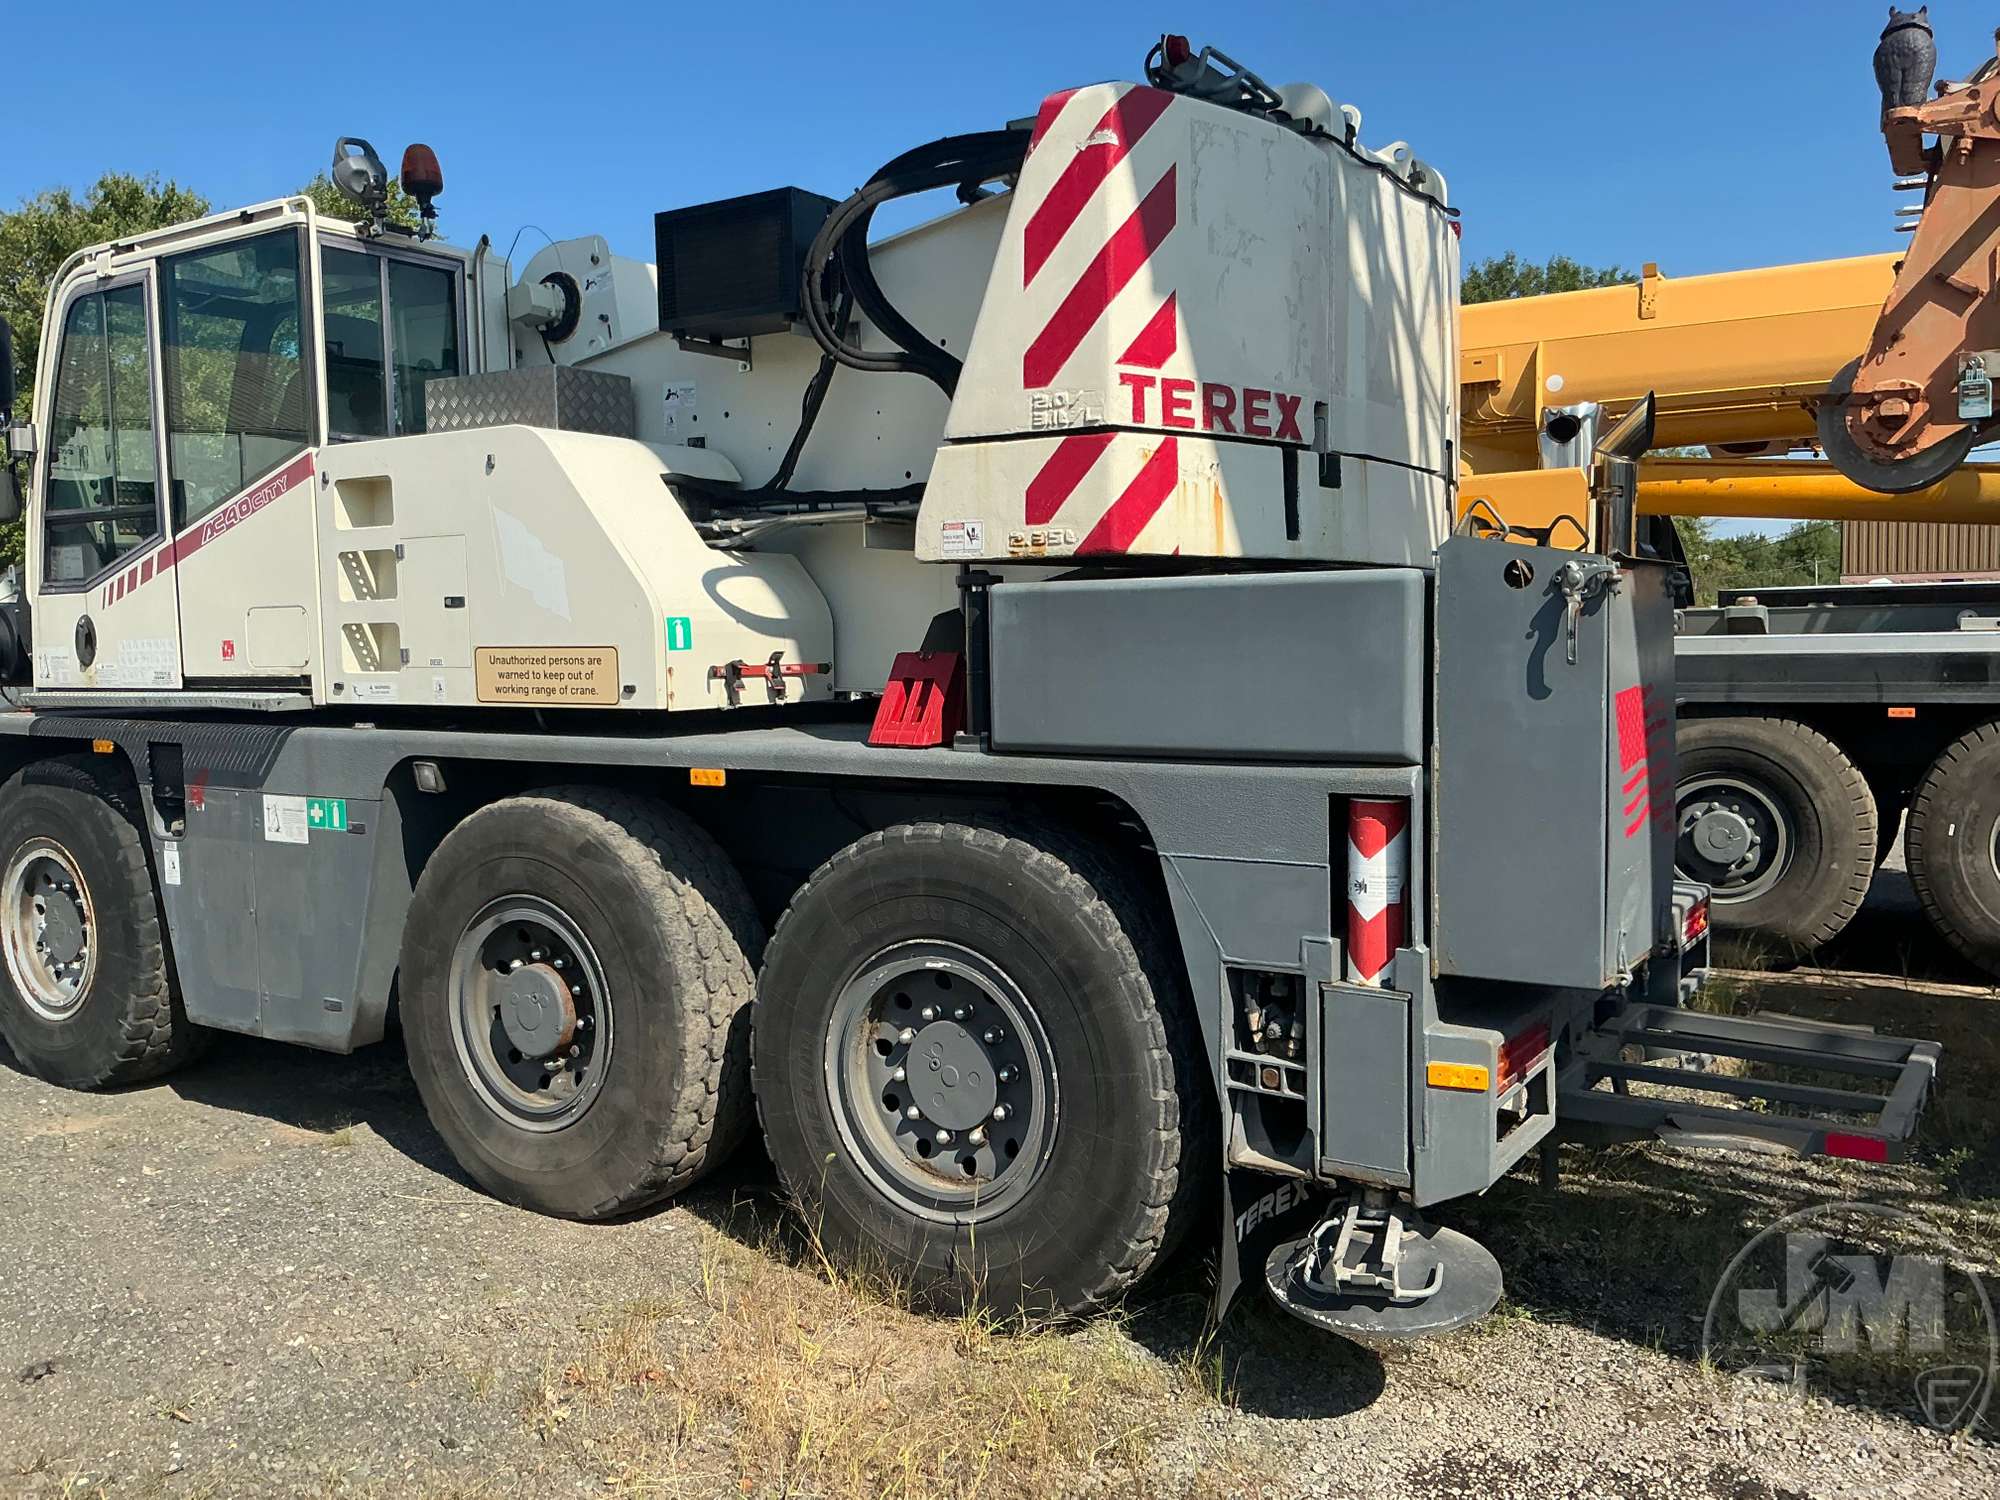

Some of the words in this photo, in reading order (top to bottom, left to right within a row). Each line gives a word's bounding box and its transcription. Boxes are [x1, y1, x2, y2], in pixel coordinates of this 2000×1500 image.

[1119, 372, 1303, 441] TEREX
[489, 655, 546, 665] Unauthorized
[549, 656, 585, 667] persons
[587, 657, 602, 665] are
[498, 670, 530, 680] warned
[532, 671, 541, 680] to
[543, 670, 565, 682] keep
[567, 671, 582, 681] out
[584, 670, 594, 681] of
[495, 684, 529, 696] working
[531, 686, 557, 696] range
[559, 685, 568, 695] of
[570, 686, 599, 696] crane.
[1236, 1178, 1310, 1243] TEREX
